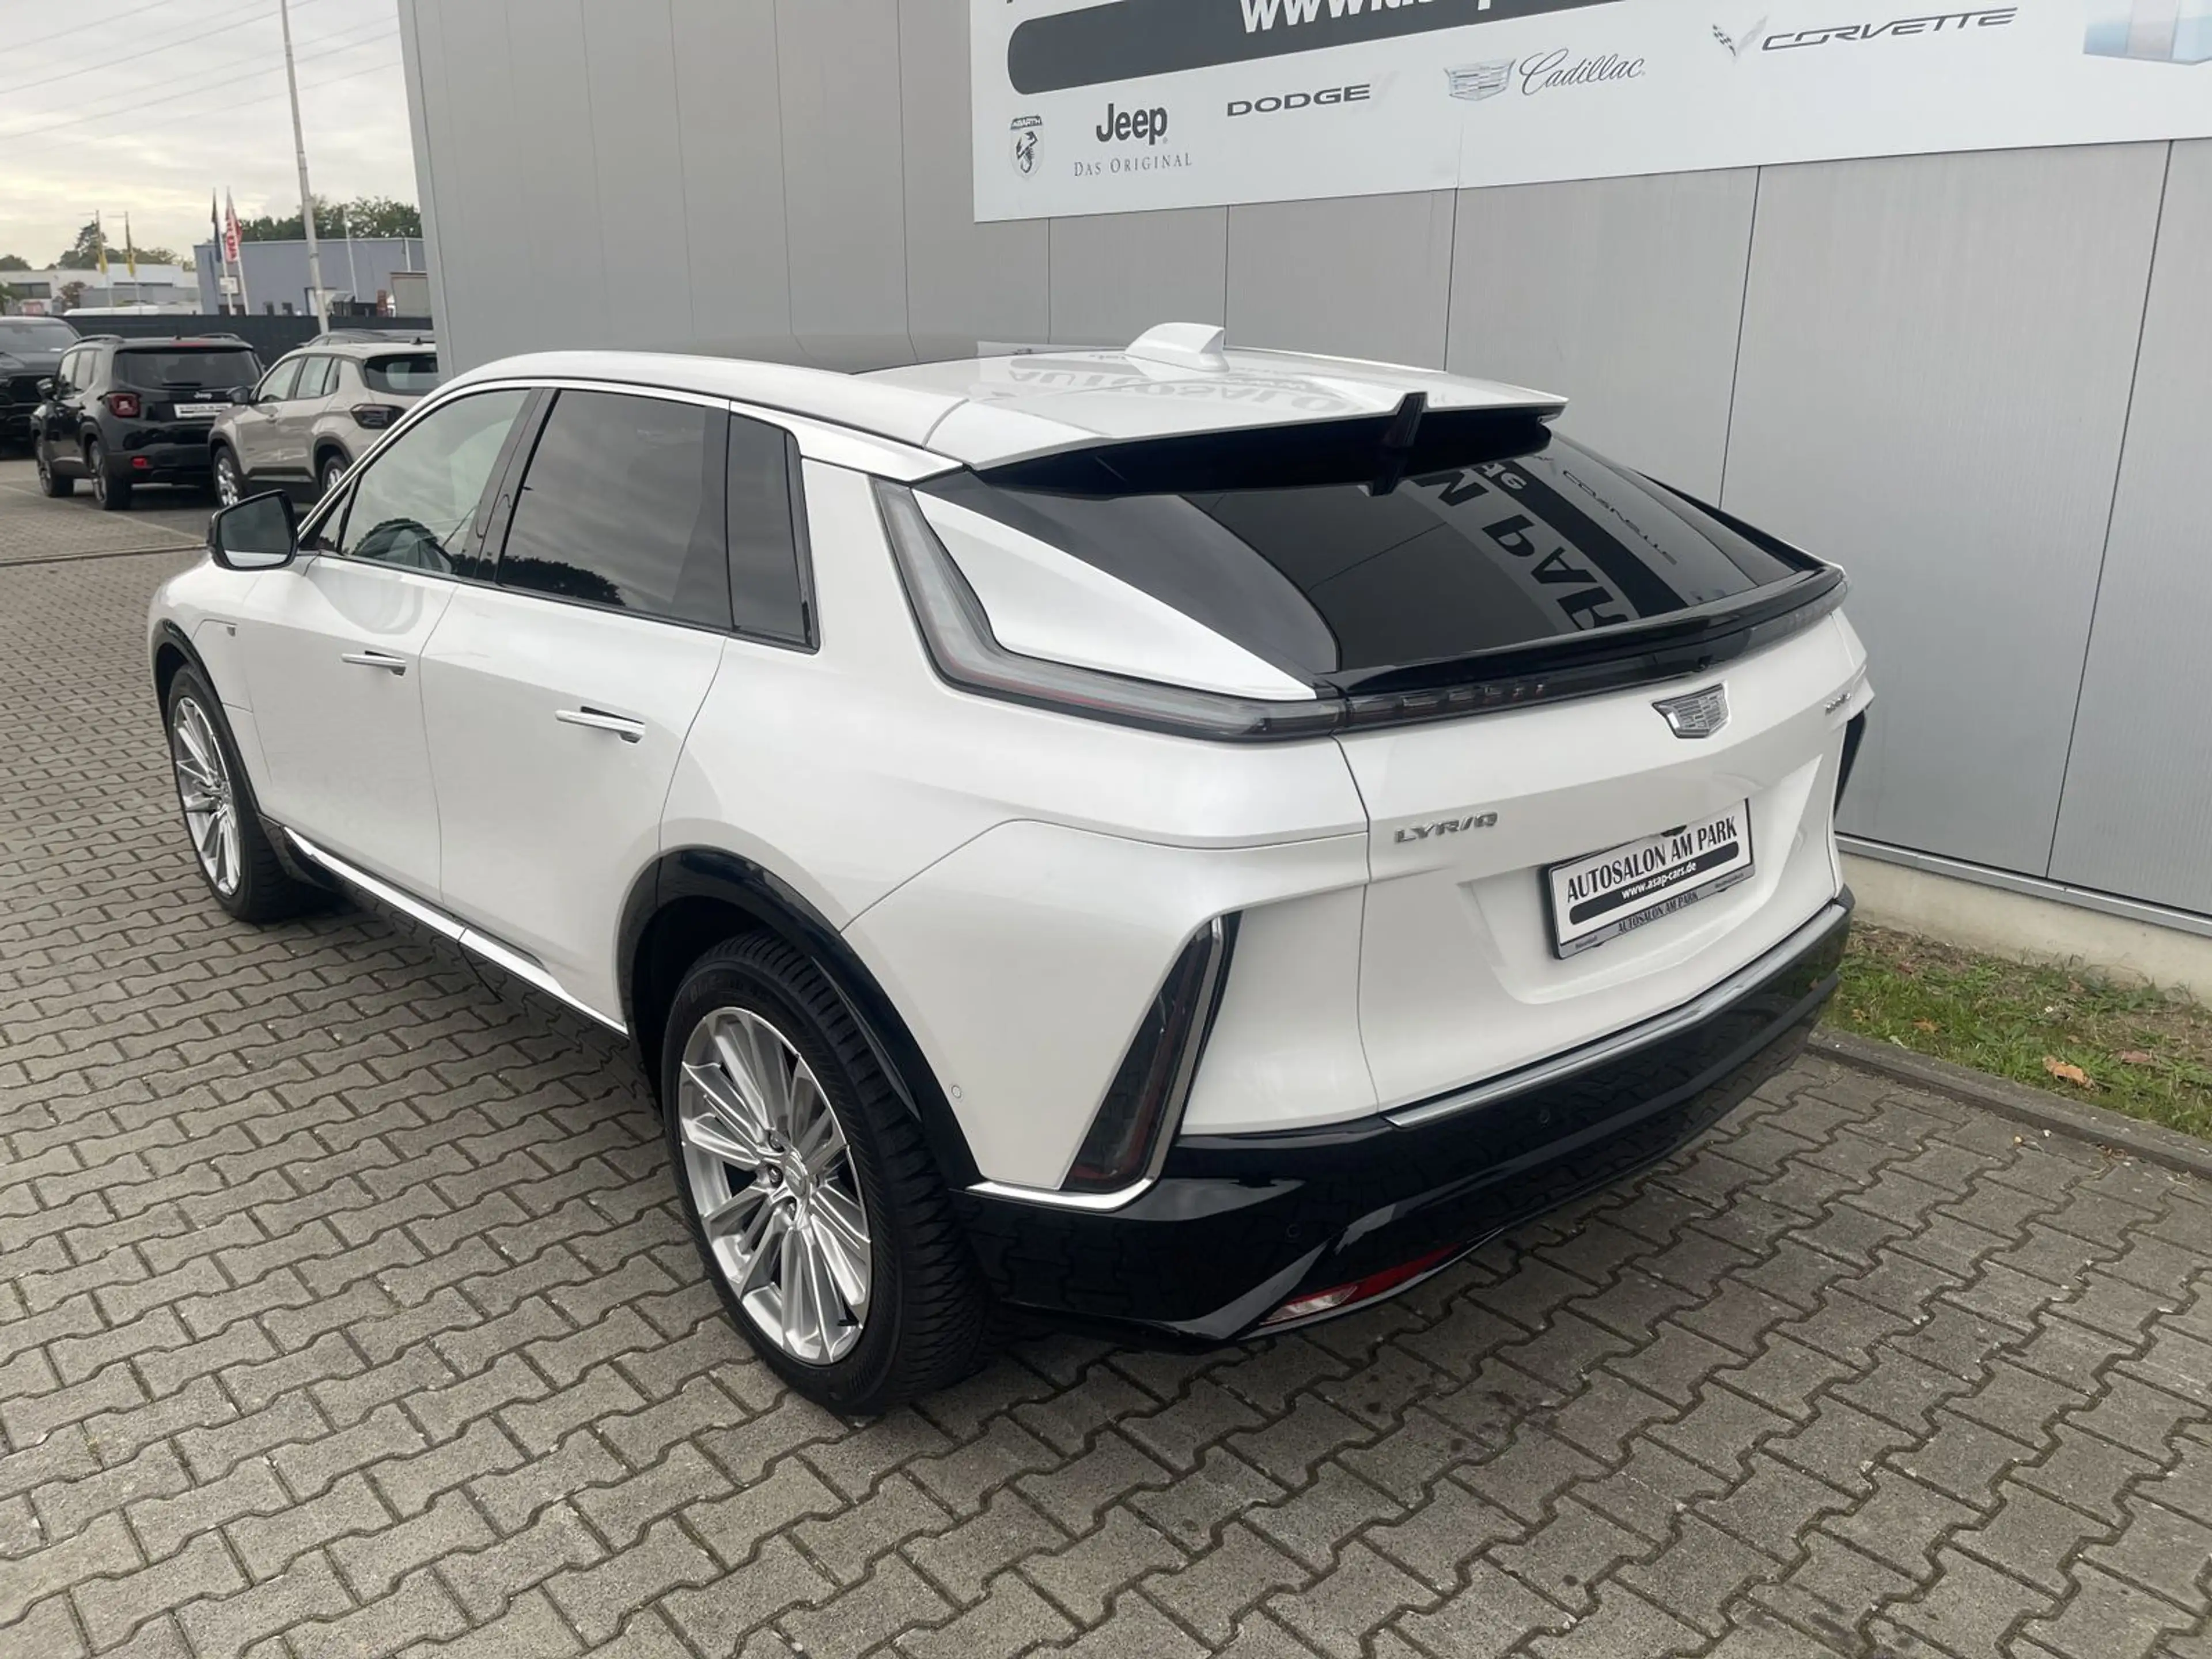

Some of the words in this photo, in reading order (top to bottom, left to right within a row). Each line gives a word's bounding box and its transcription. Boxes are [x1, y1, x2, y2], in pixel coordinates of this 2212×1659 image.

[1762, 7, 2018, 51] CORVETTE
[1518, 48, 1645, 96] Cadillac
[1227, 84, 1371, 116] DODGE
[1096, 103, 1168, 146] Jeep
[1567, 844, 1666, 904] AUTOSALON
[1671, 833, 1693, 862] AM
[1698, 816, 1737, 851] PARK
[1621, 861, 1697, 900] www.asap-cars.de
